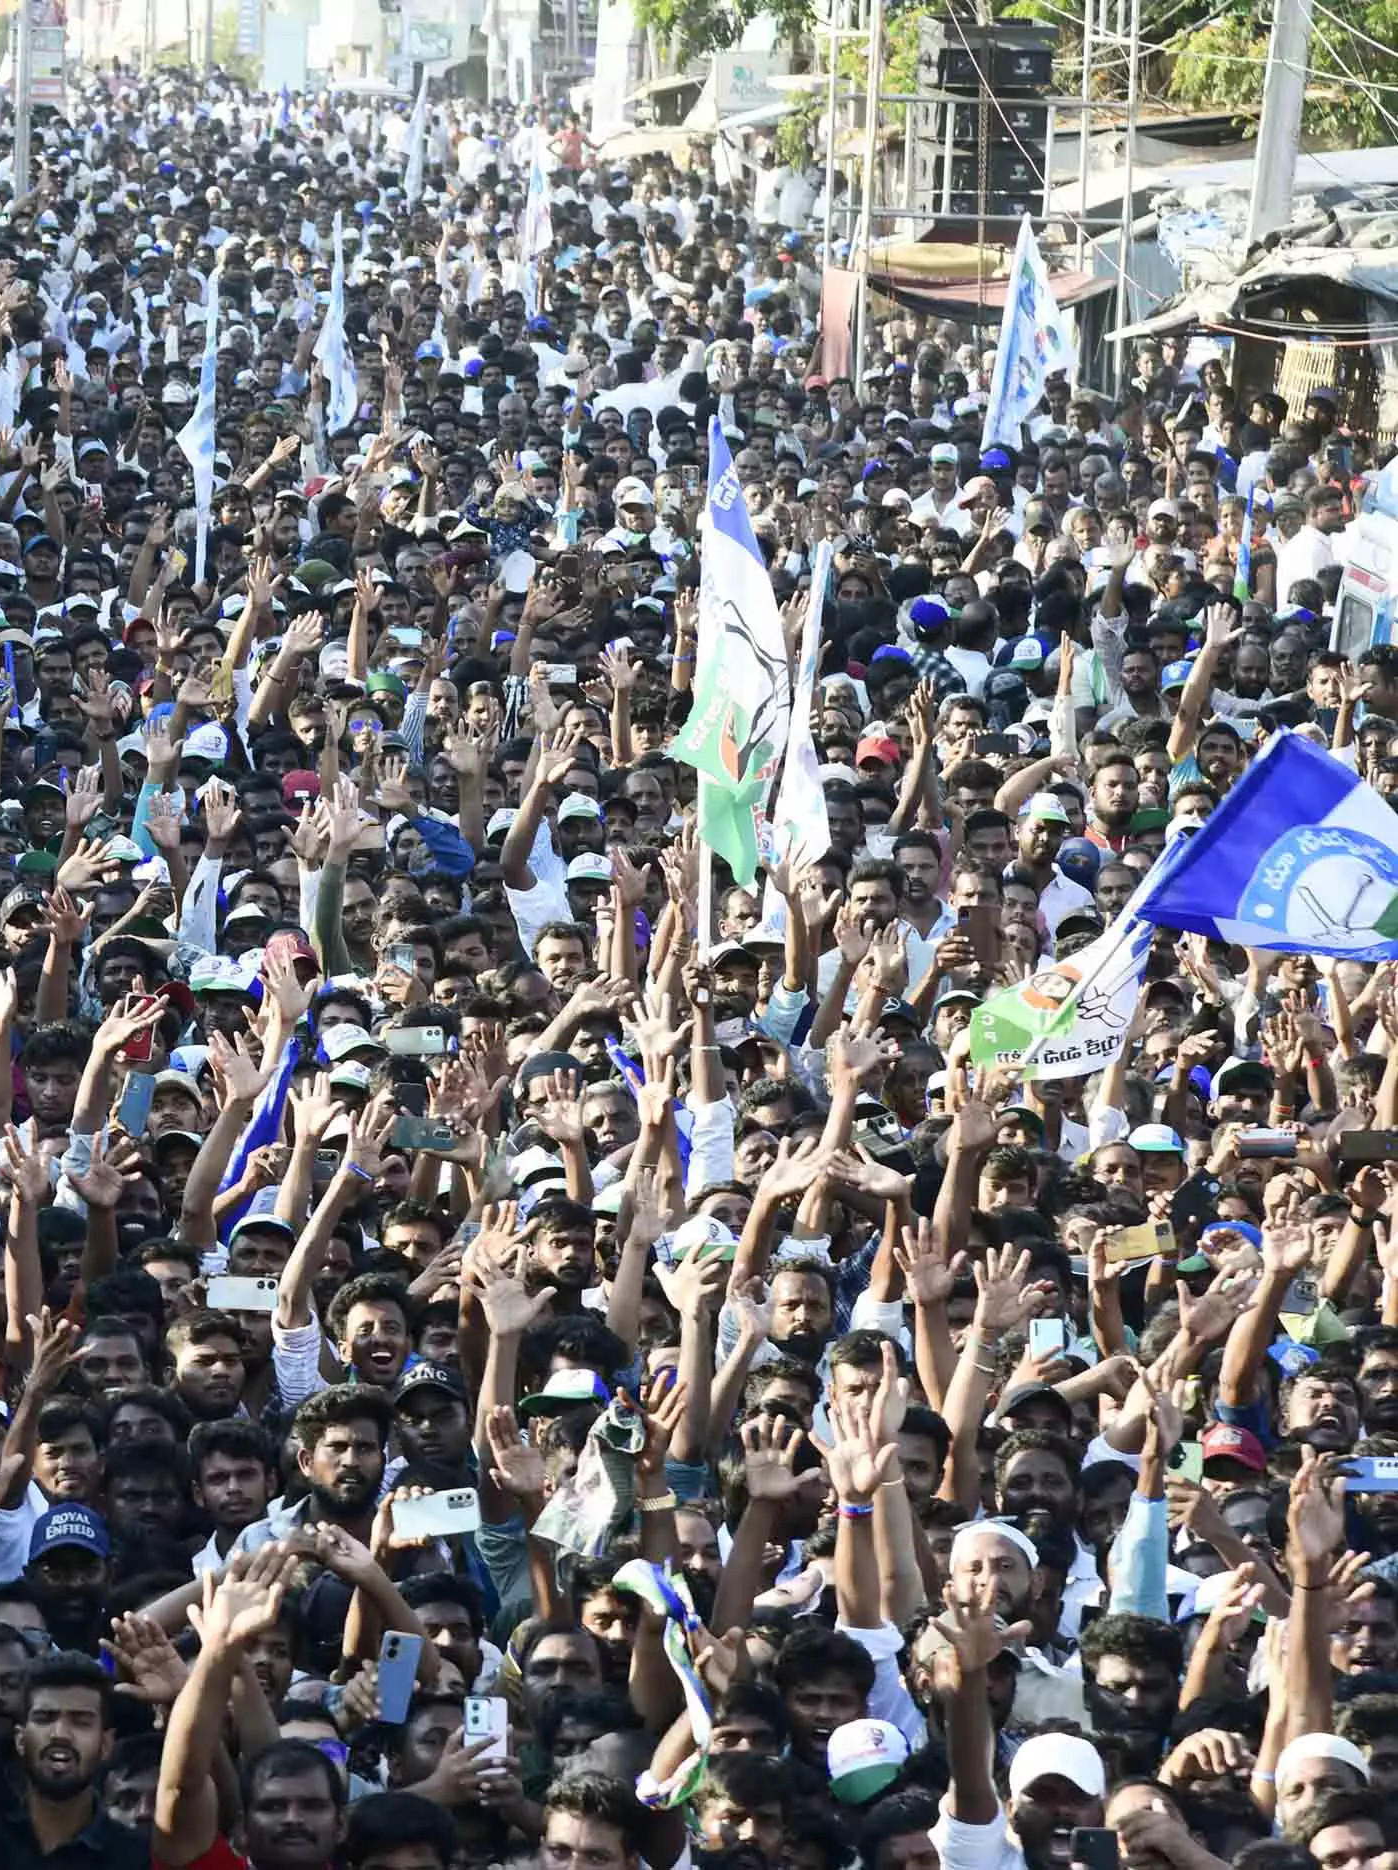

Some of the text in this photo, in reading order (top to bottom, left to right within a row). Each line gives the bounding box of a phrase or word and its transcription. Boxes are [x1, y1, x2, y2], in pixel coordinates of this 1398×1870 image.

[403, 1362, 449, 1387] KING
[50, 1510, 91, 1526] ROYAL
[44, 1522, 96, 1541] ENFIELD
